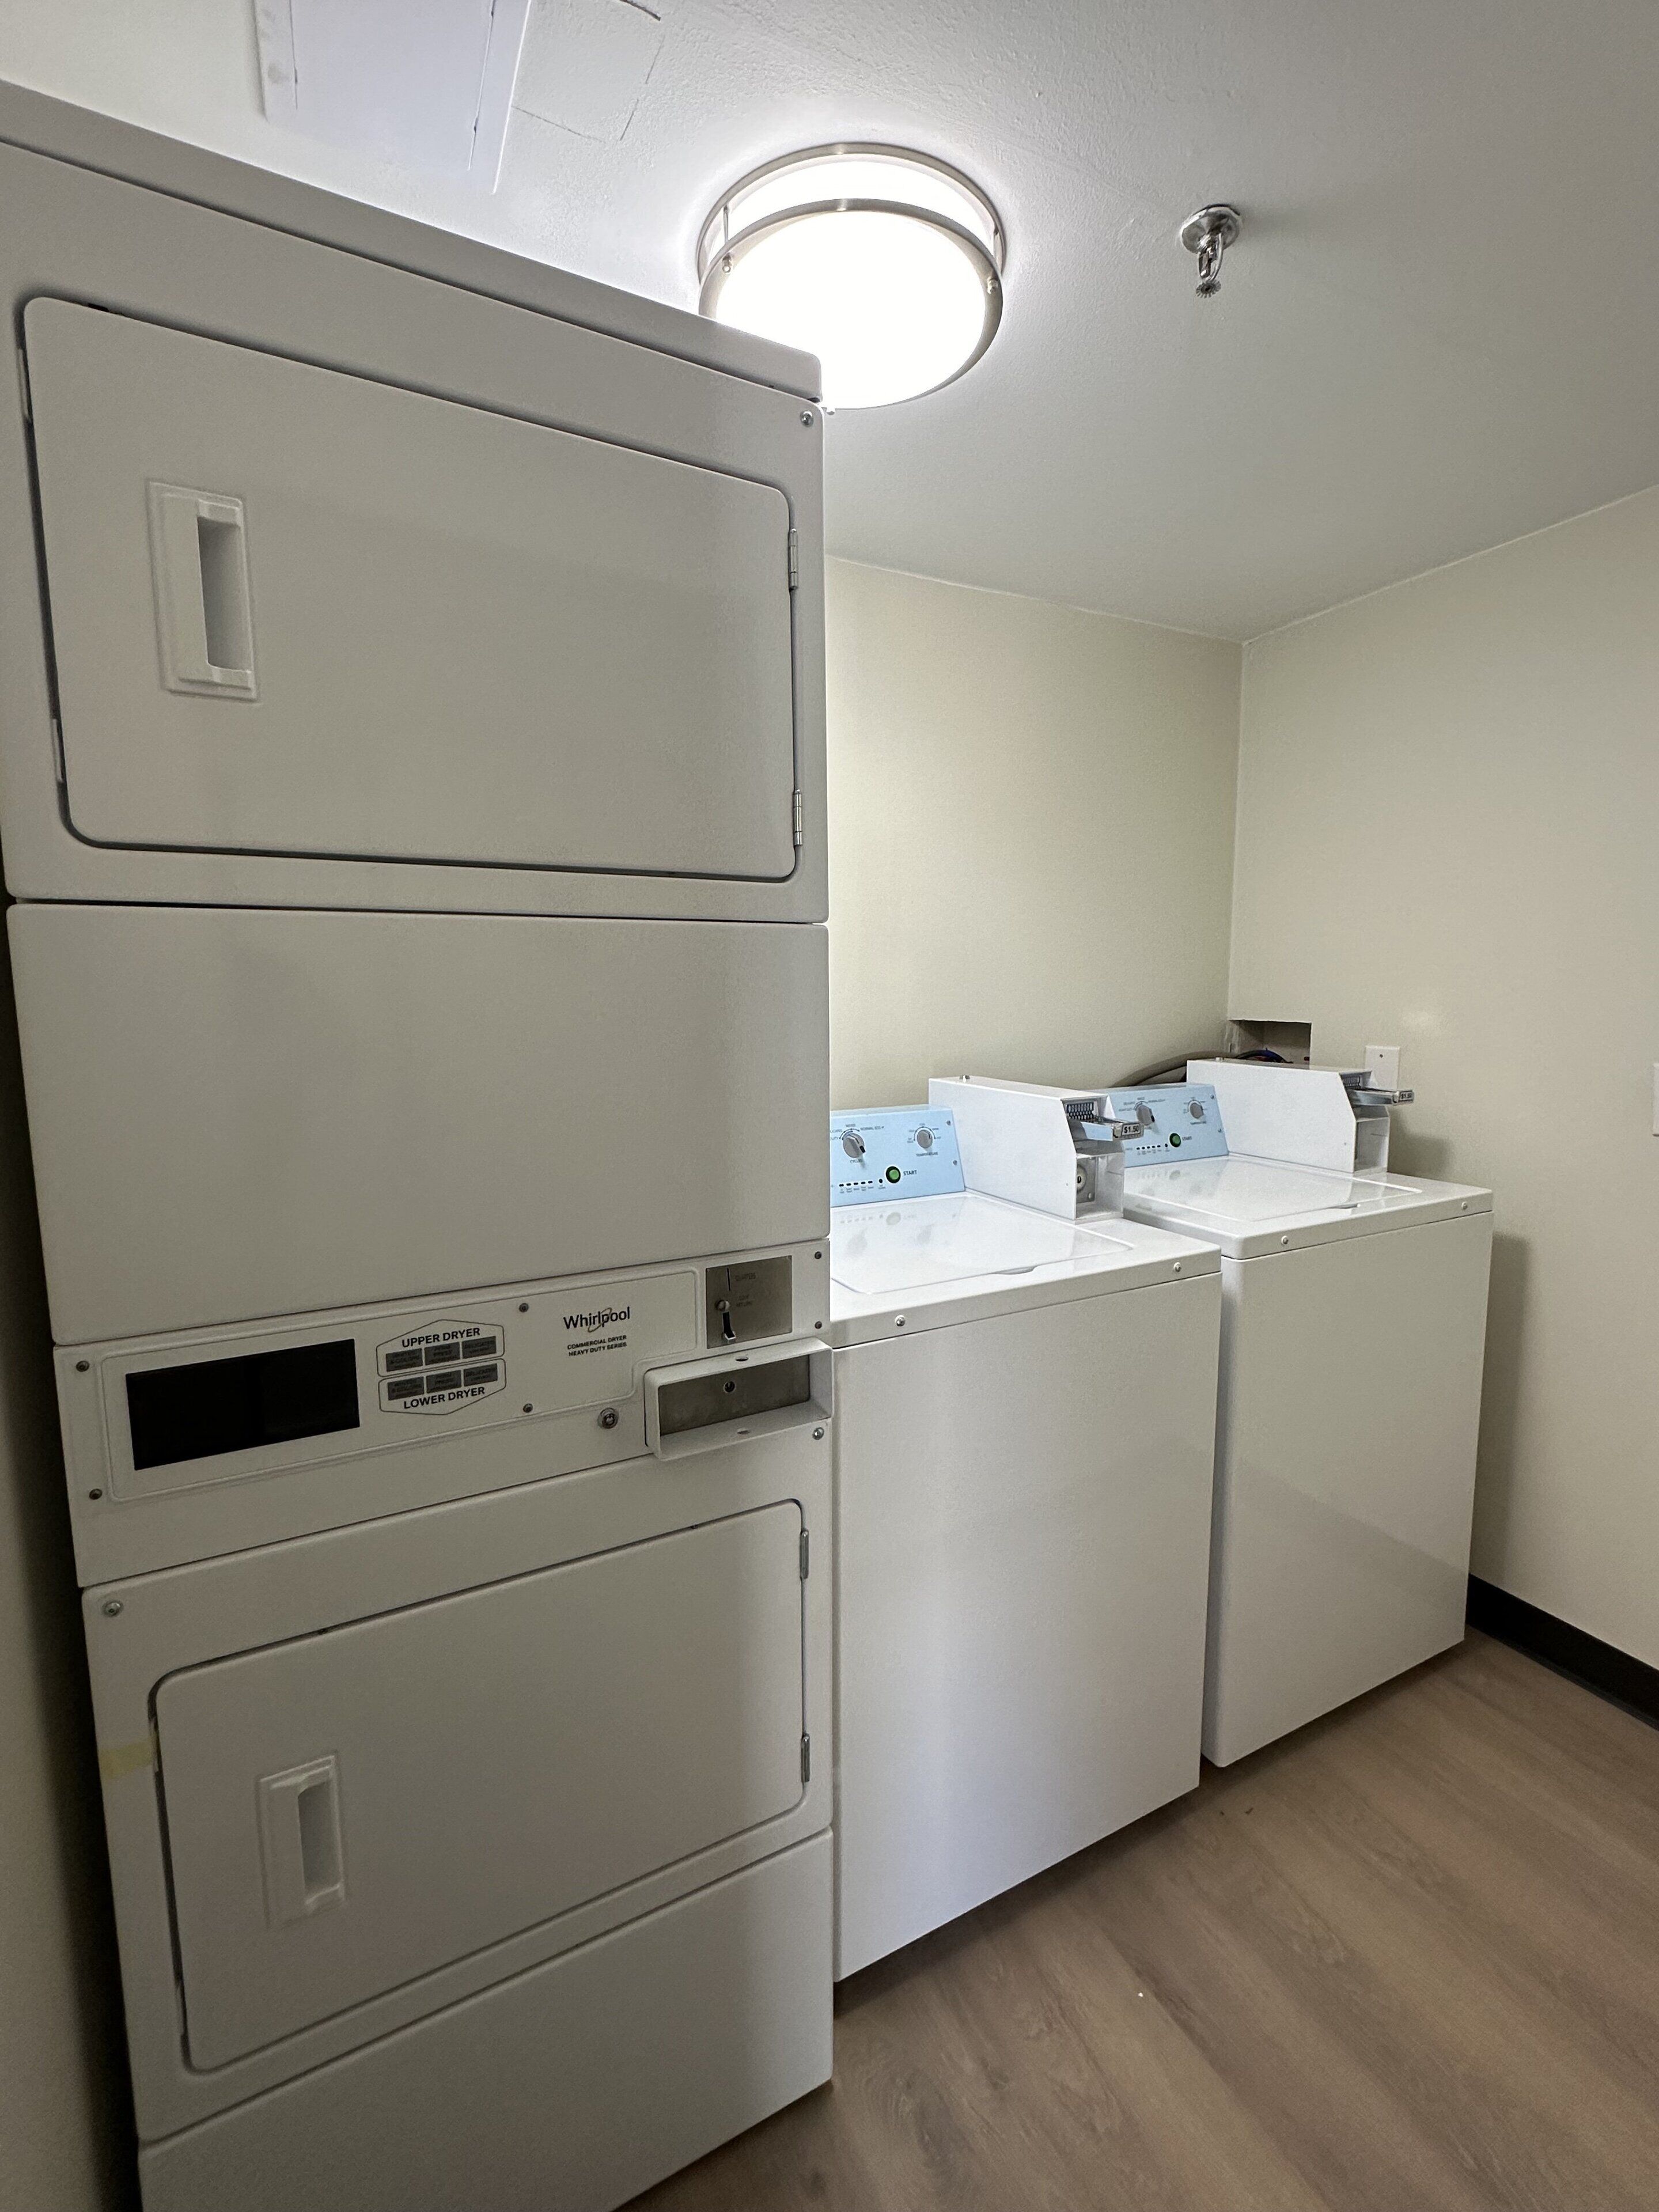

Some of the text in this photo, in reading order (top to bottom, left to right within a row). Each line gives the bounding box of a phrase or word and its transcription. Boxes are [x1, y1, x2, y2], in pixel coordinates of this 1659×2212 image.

[1124, 1125, 1139, 1133] $1.50
[563, 1306, 630, 1330] Whirlpool
[402, 1327, 480, 1347] UPPER DRYER
[567, 1335, 627, 1350] COMMERCIAL DRYER
[607, 1342, 627, 1350] SERIES
[404, 1387, 485, 1409] LOWER DRYER
